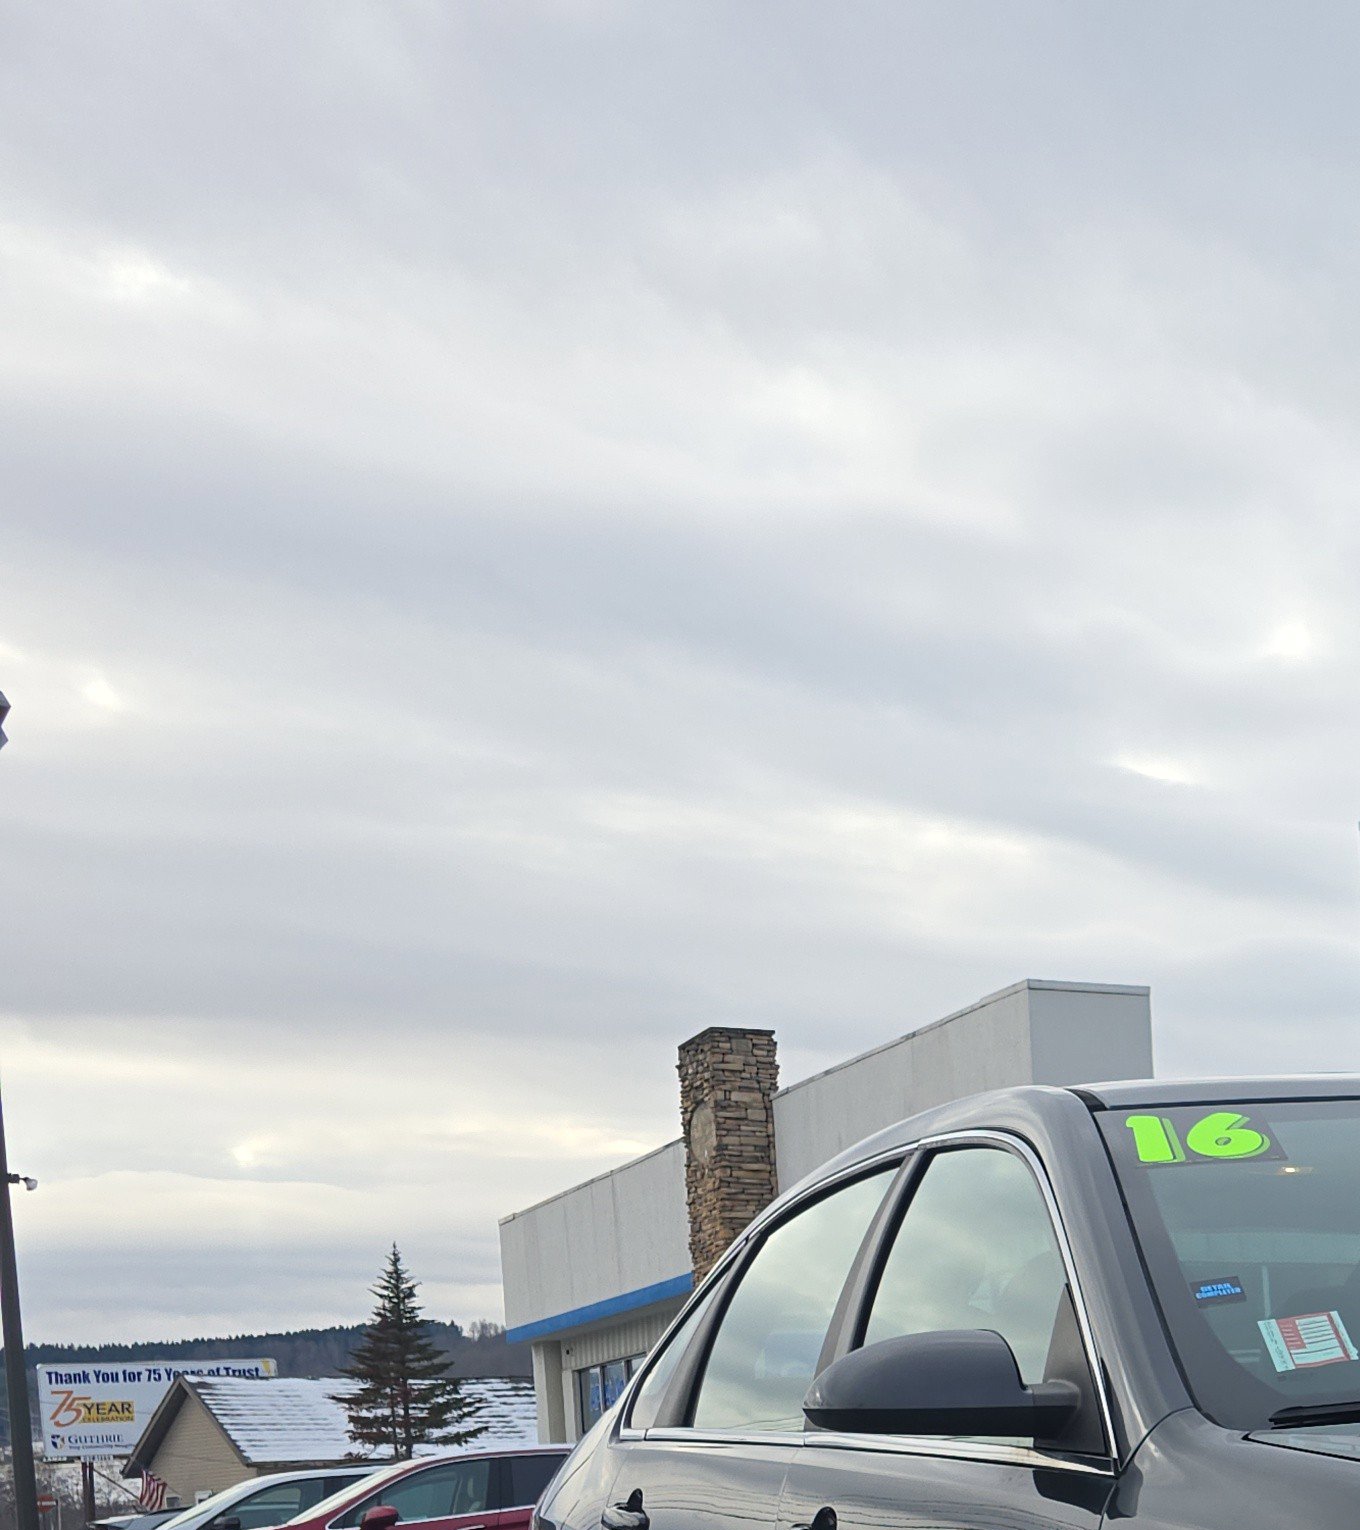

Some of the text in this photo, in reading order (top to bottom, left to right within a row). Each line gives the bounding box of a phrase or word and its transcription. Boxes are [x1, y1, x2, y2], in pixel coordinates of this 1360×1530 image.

[1125, 1112, 1271, 1163] 16
[46, 1369, 91, 1386] Thank
[92, 1368, 120, 1383] You
[122, 1368, 142, 1383] for
[145, 1367, 162, 1382] 75
[223, 1366, 260, 1379] Trust
[50, 1390, 132, 1428] 75 YEAR
[68, 1433, 124, 1445] GUTHRIE
